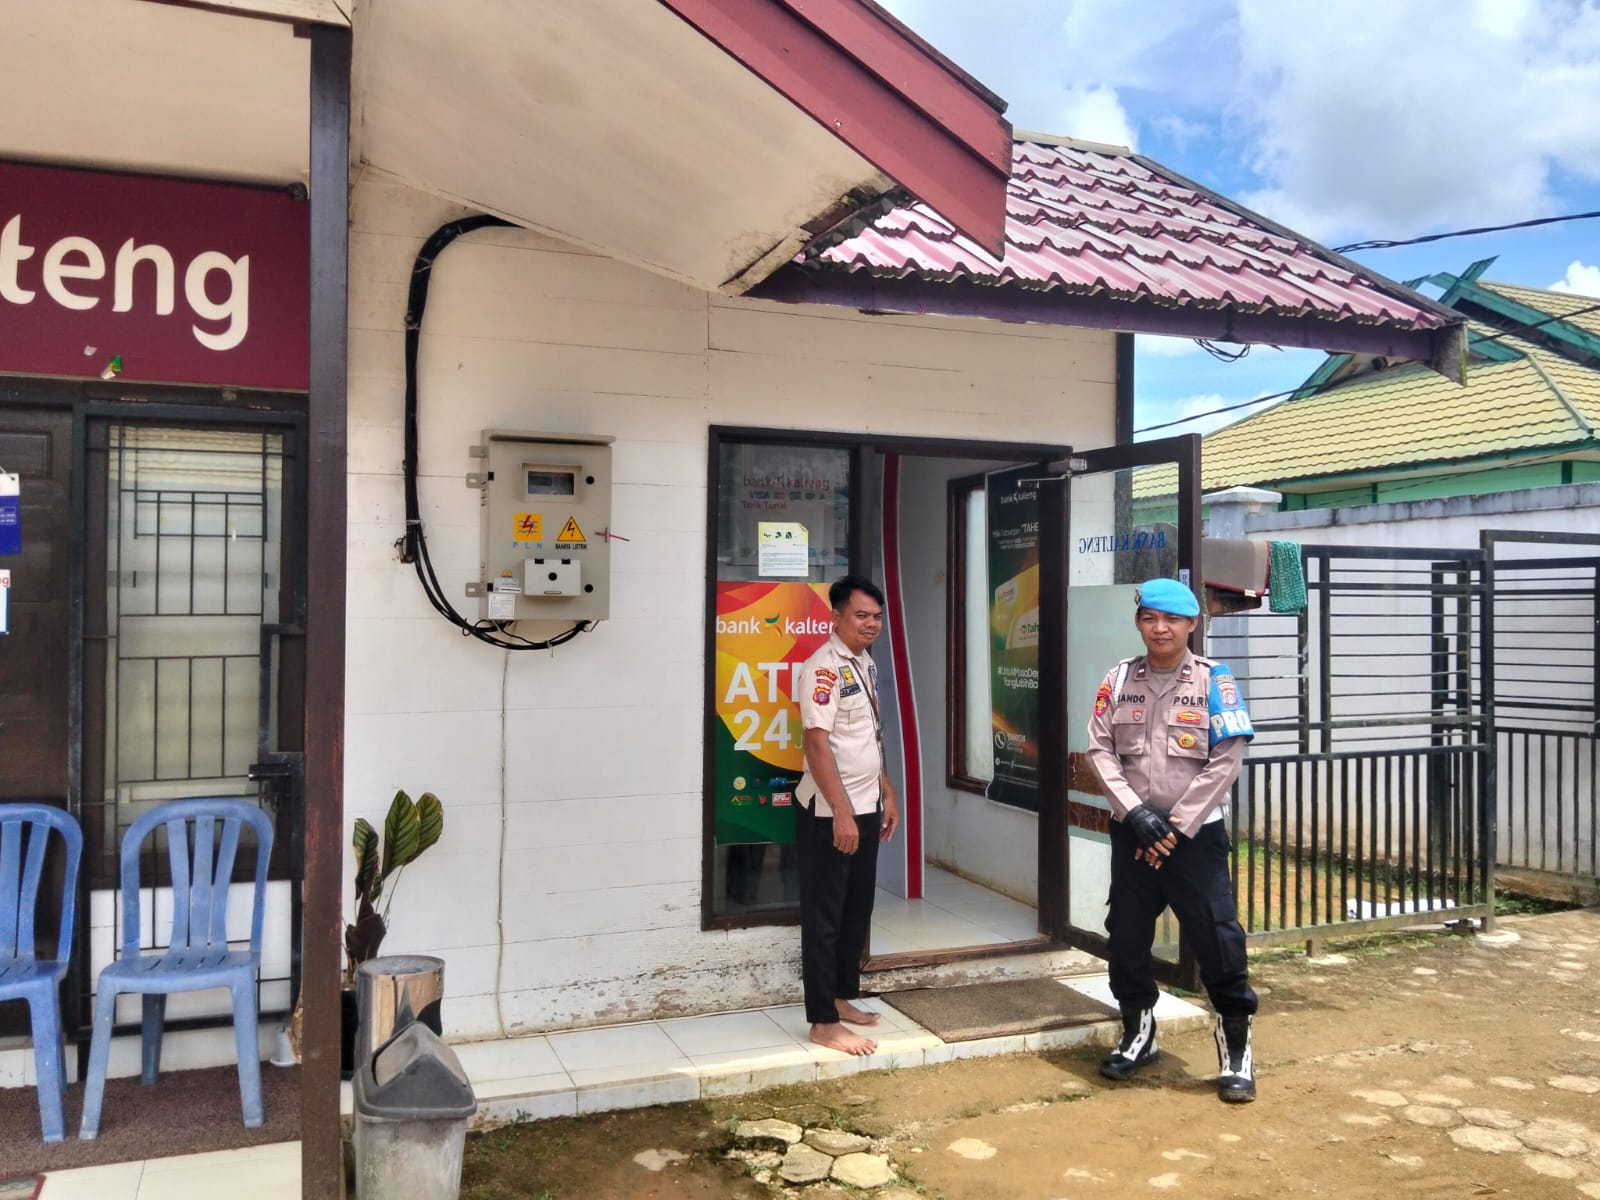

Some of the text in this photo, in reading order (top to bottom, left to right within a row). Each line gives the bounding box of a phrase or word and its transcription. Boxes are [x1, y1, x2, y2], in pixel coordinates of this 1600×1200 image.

[0, 214, 250, 351] teng
[716, 616, 761, 635] bank
[733, 709, 792, 751] 24
